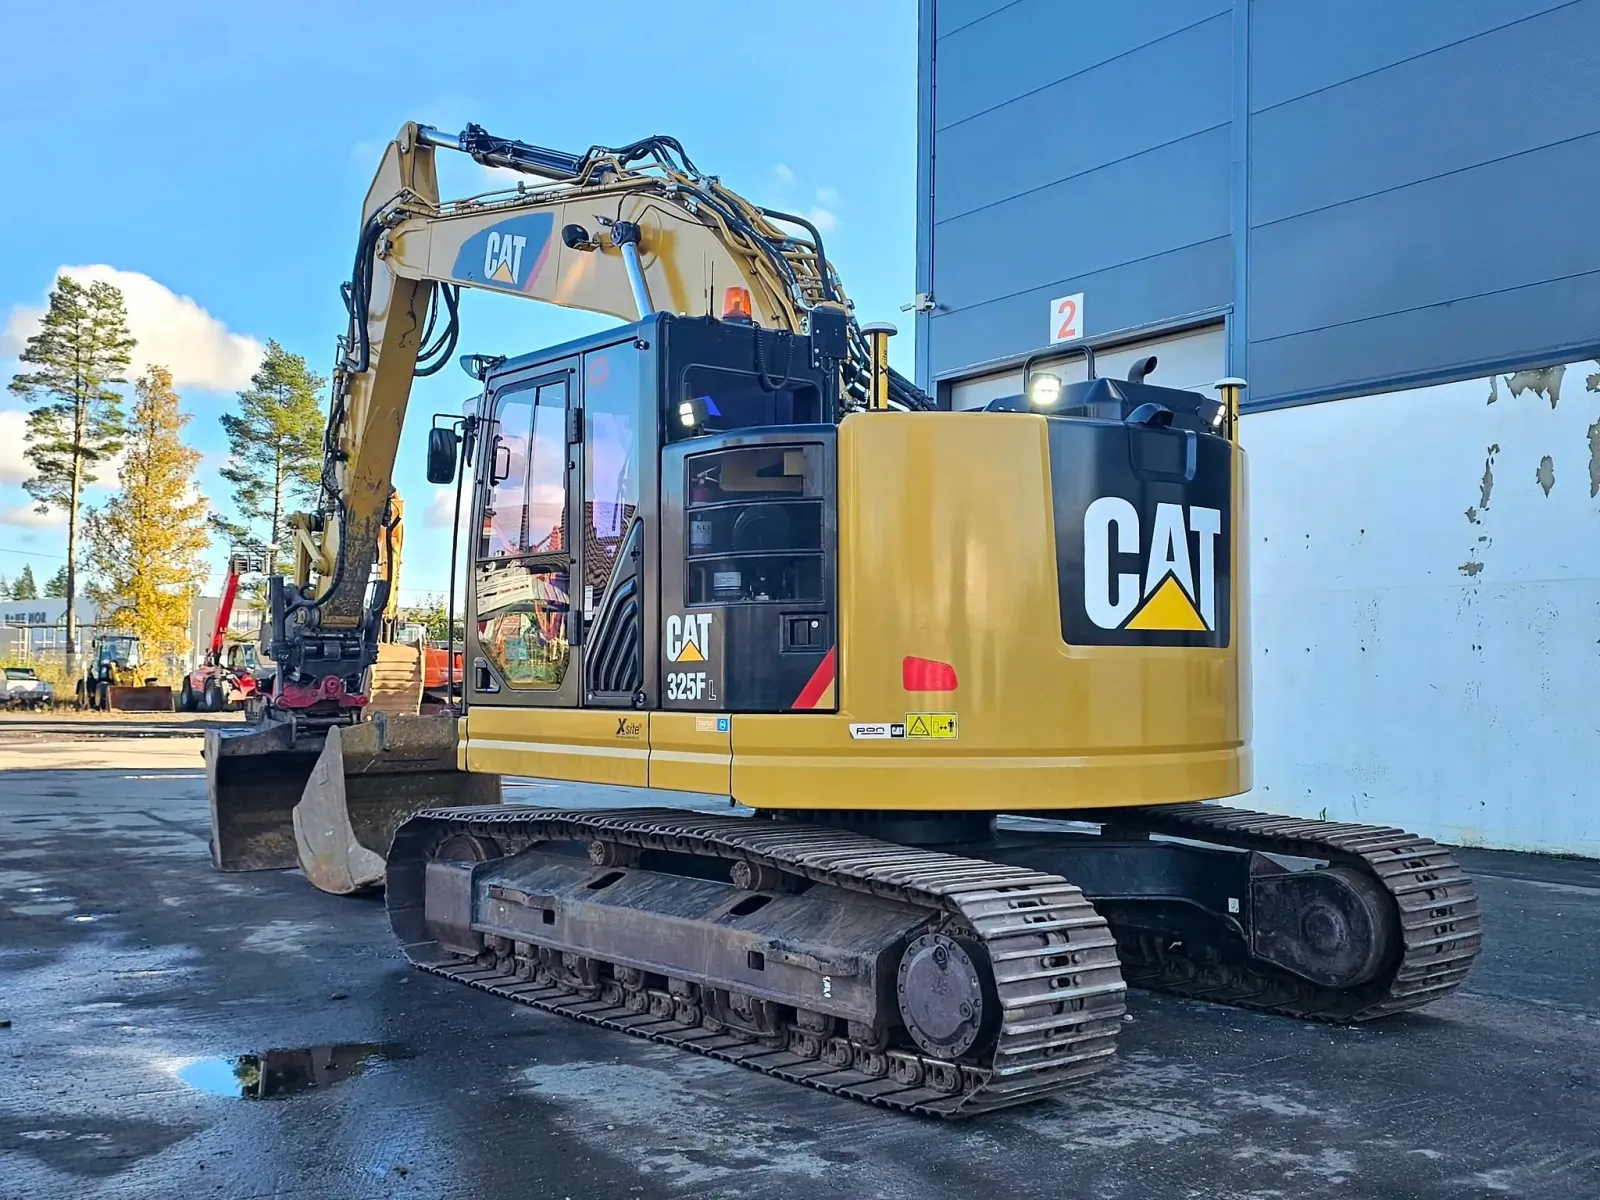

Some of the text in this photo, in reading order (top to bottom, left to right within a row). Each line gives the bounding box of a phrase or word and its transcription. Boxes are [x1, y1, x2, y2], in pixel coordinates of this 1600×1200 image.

[484, 231, 527, 284] CAT
[1057, 299, 1076, 339] 2
[1084, 496, 1221, 631] CAT
[666, 613, 712, 662] CAT
[667, 672, 716, 700] 325F L
